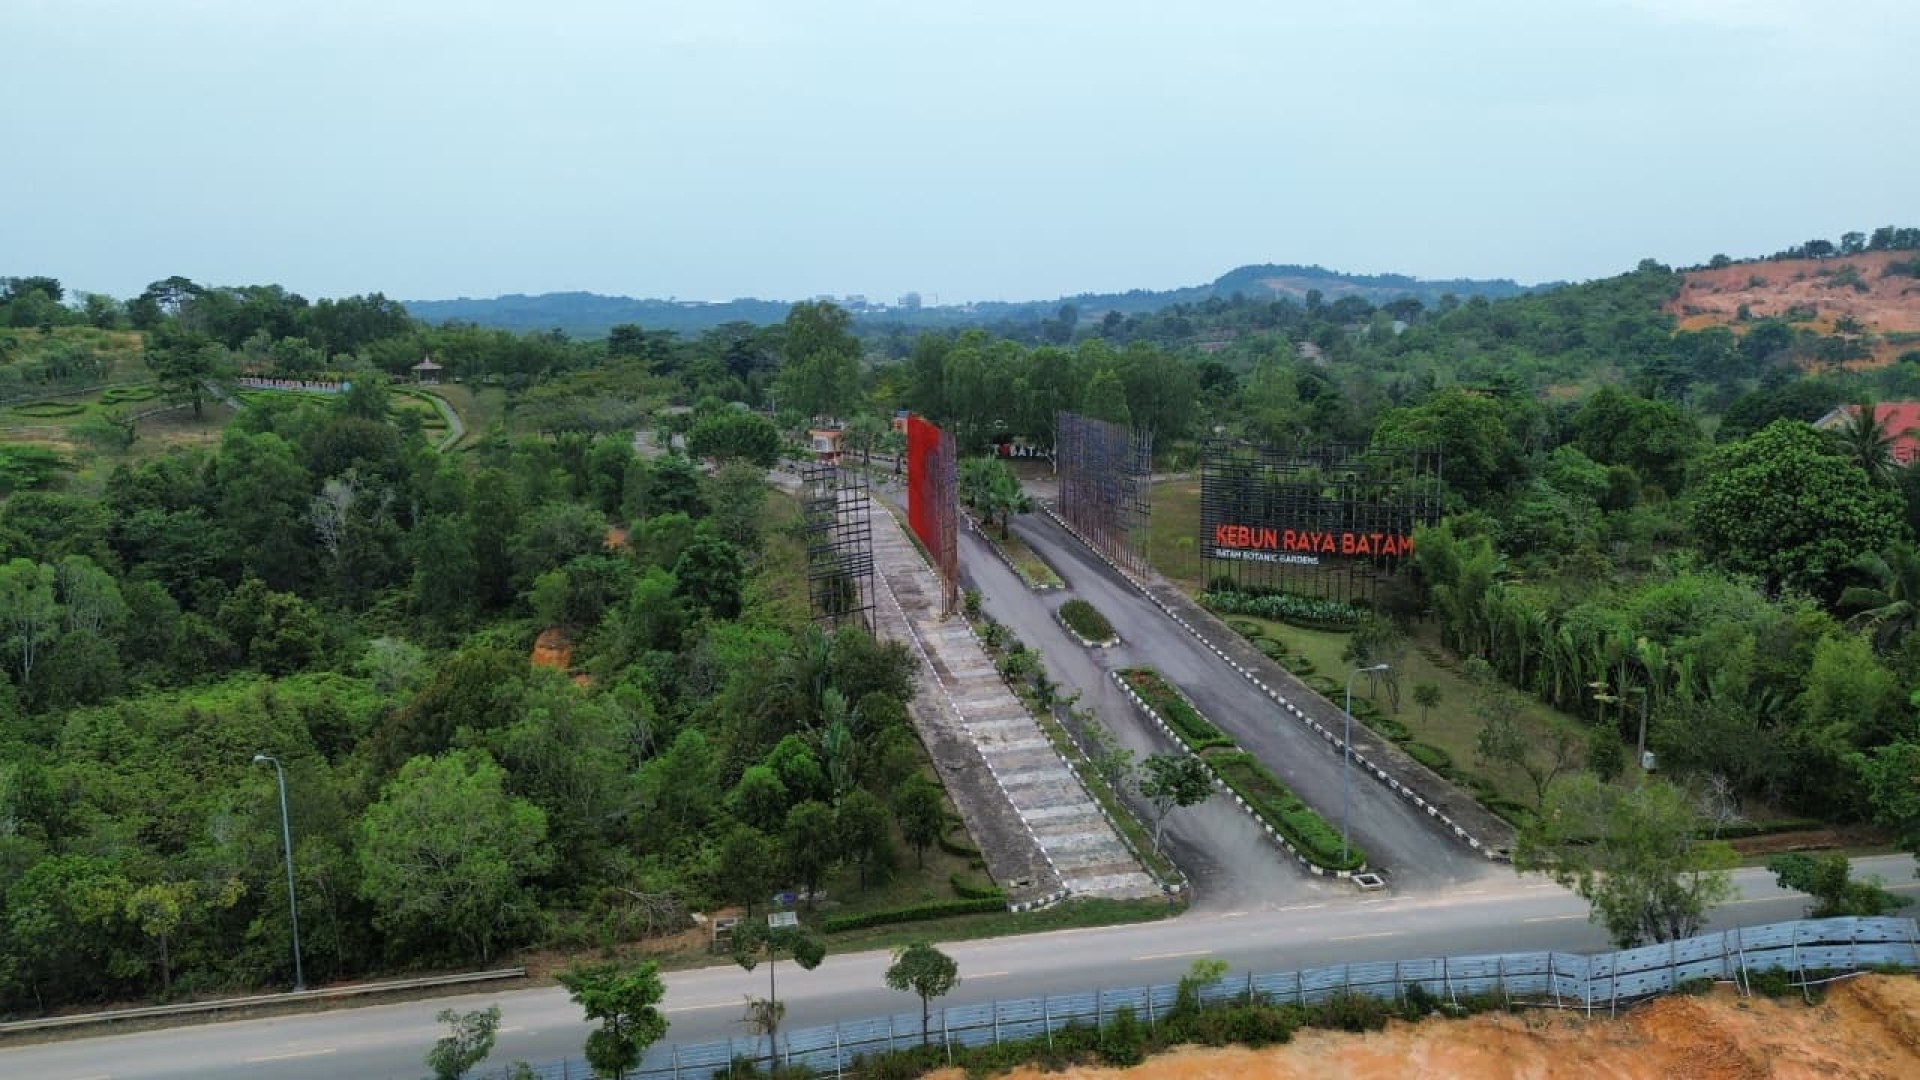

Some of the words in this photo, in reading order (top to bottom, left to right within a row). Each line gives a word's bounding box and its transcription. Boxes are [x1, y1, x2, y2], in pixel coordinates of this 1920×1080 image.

[1215, 523, 1277, 549] KEBUN
[1283, 529, 1336, 553] RAYA
[1342, 533, 1415, 556] BATAM
[1215, 549, 1241, 559] BATAM
[1243, 551, 1277, 562] BOTANIC
[1279, 555, 1320, 565] GARDENS
